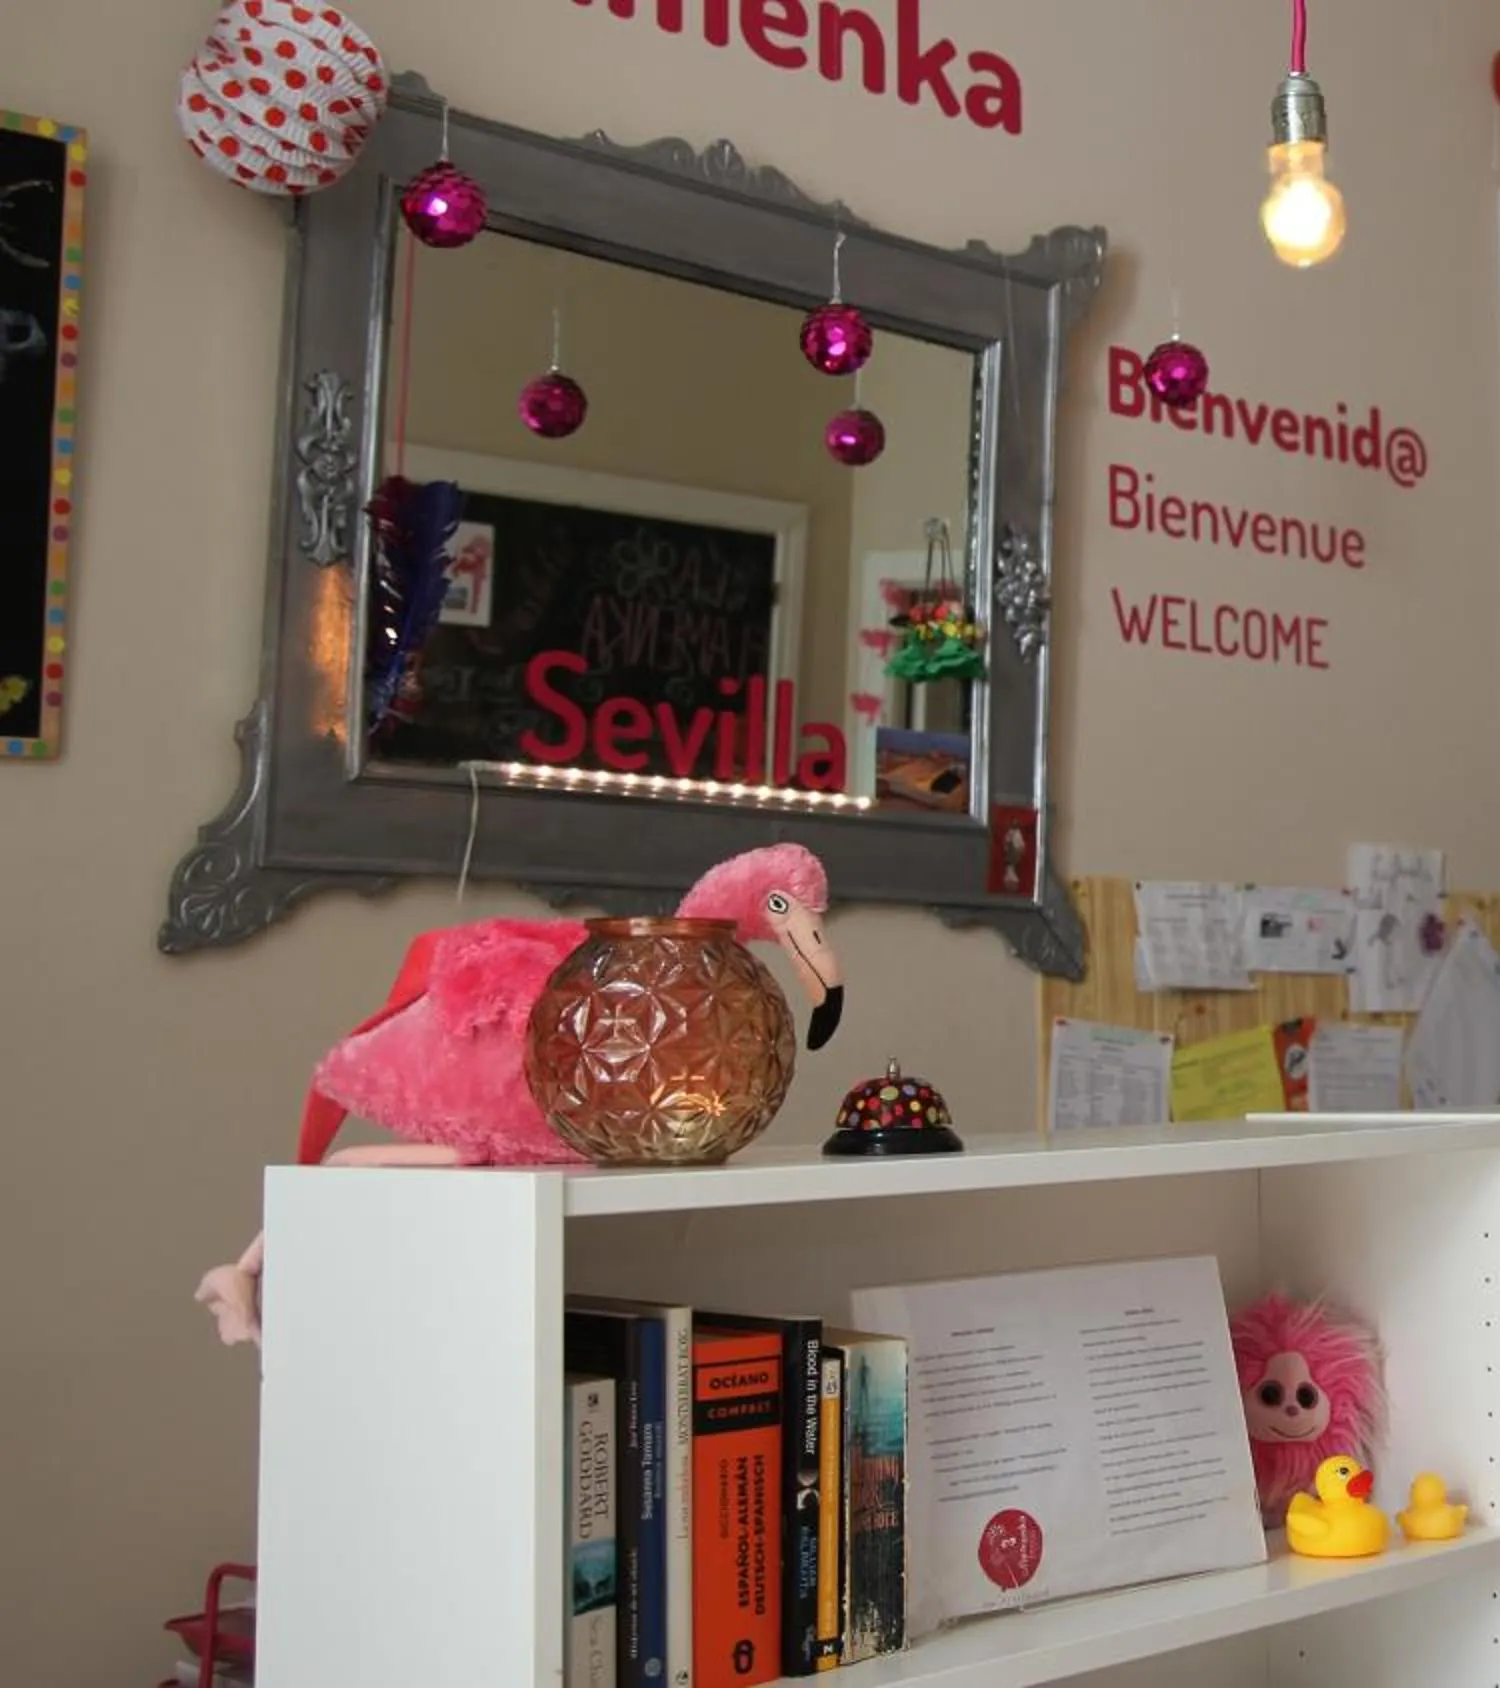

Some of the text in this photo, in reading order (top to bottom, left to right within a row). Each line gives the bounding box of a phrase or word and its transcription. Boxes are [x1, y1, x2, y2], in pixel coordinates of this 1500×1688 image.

[570, 0, 1023, 135] enka
[1108, 464, 1365, 569] Bienvenue
[1111, 588, 1329, 669] WELCOME
[519, 649, 847, 793] Sevilla
[804, 1339, 819, 1455] Blood in the Water
[579, 1420, 593, 1539] GODDARD
[593, 1432, 609, 1520] ROBERT
[641, 1469, 653, 1520] Susanna
